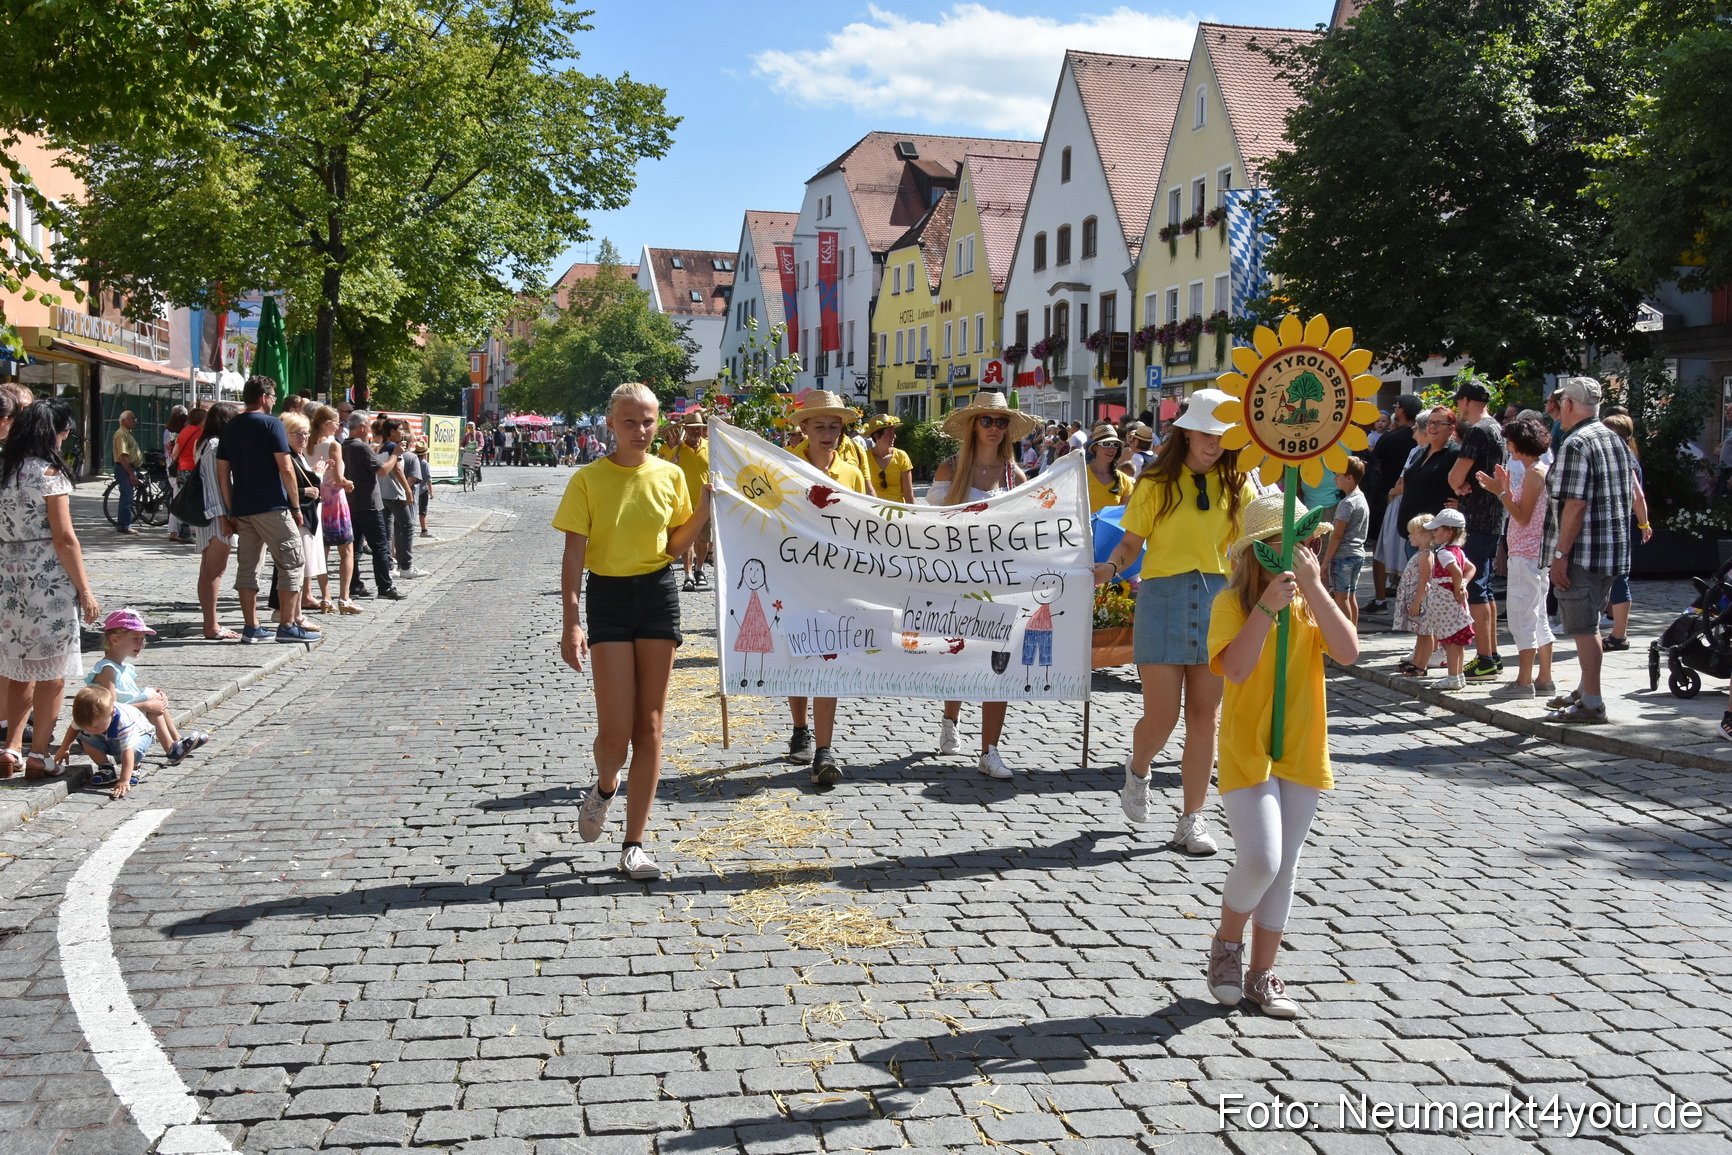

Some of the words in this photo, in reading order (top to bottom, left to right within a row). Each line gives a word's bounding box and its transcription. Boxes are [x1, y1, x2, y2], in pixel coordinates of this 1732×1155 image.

[821, 236, 831, 264] K&L
[899, 309, 915, 324] HOTEL
[896, 380, 918, 390] Restaurant
[954, 366, 967, 376] AIFUN
[1149, 369, 1159, 386] P
[1254, 384, 1267, 422] OGV
[1273, 355, 1346, 422] TYROLSBERG
[1278, 437, 1319, 453] 1980
[742, 472, 773, 500] OGV
[821, 514, 1079, 554] TYROLSBERGER
[779, 536, 1022, 586] GARTENSTROLCHE
[902, 595, 1013, 641] heimatverbunden
[788, 616, 878, 654] weltoffen
